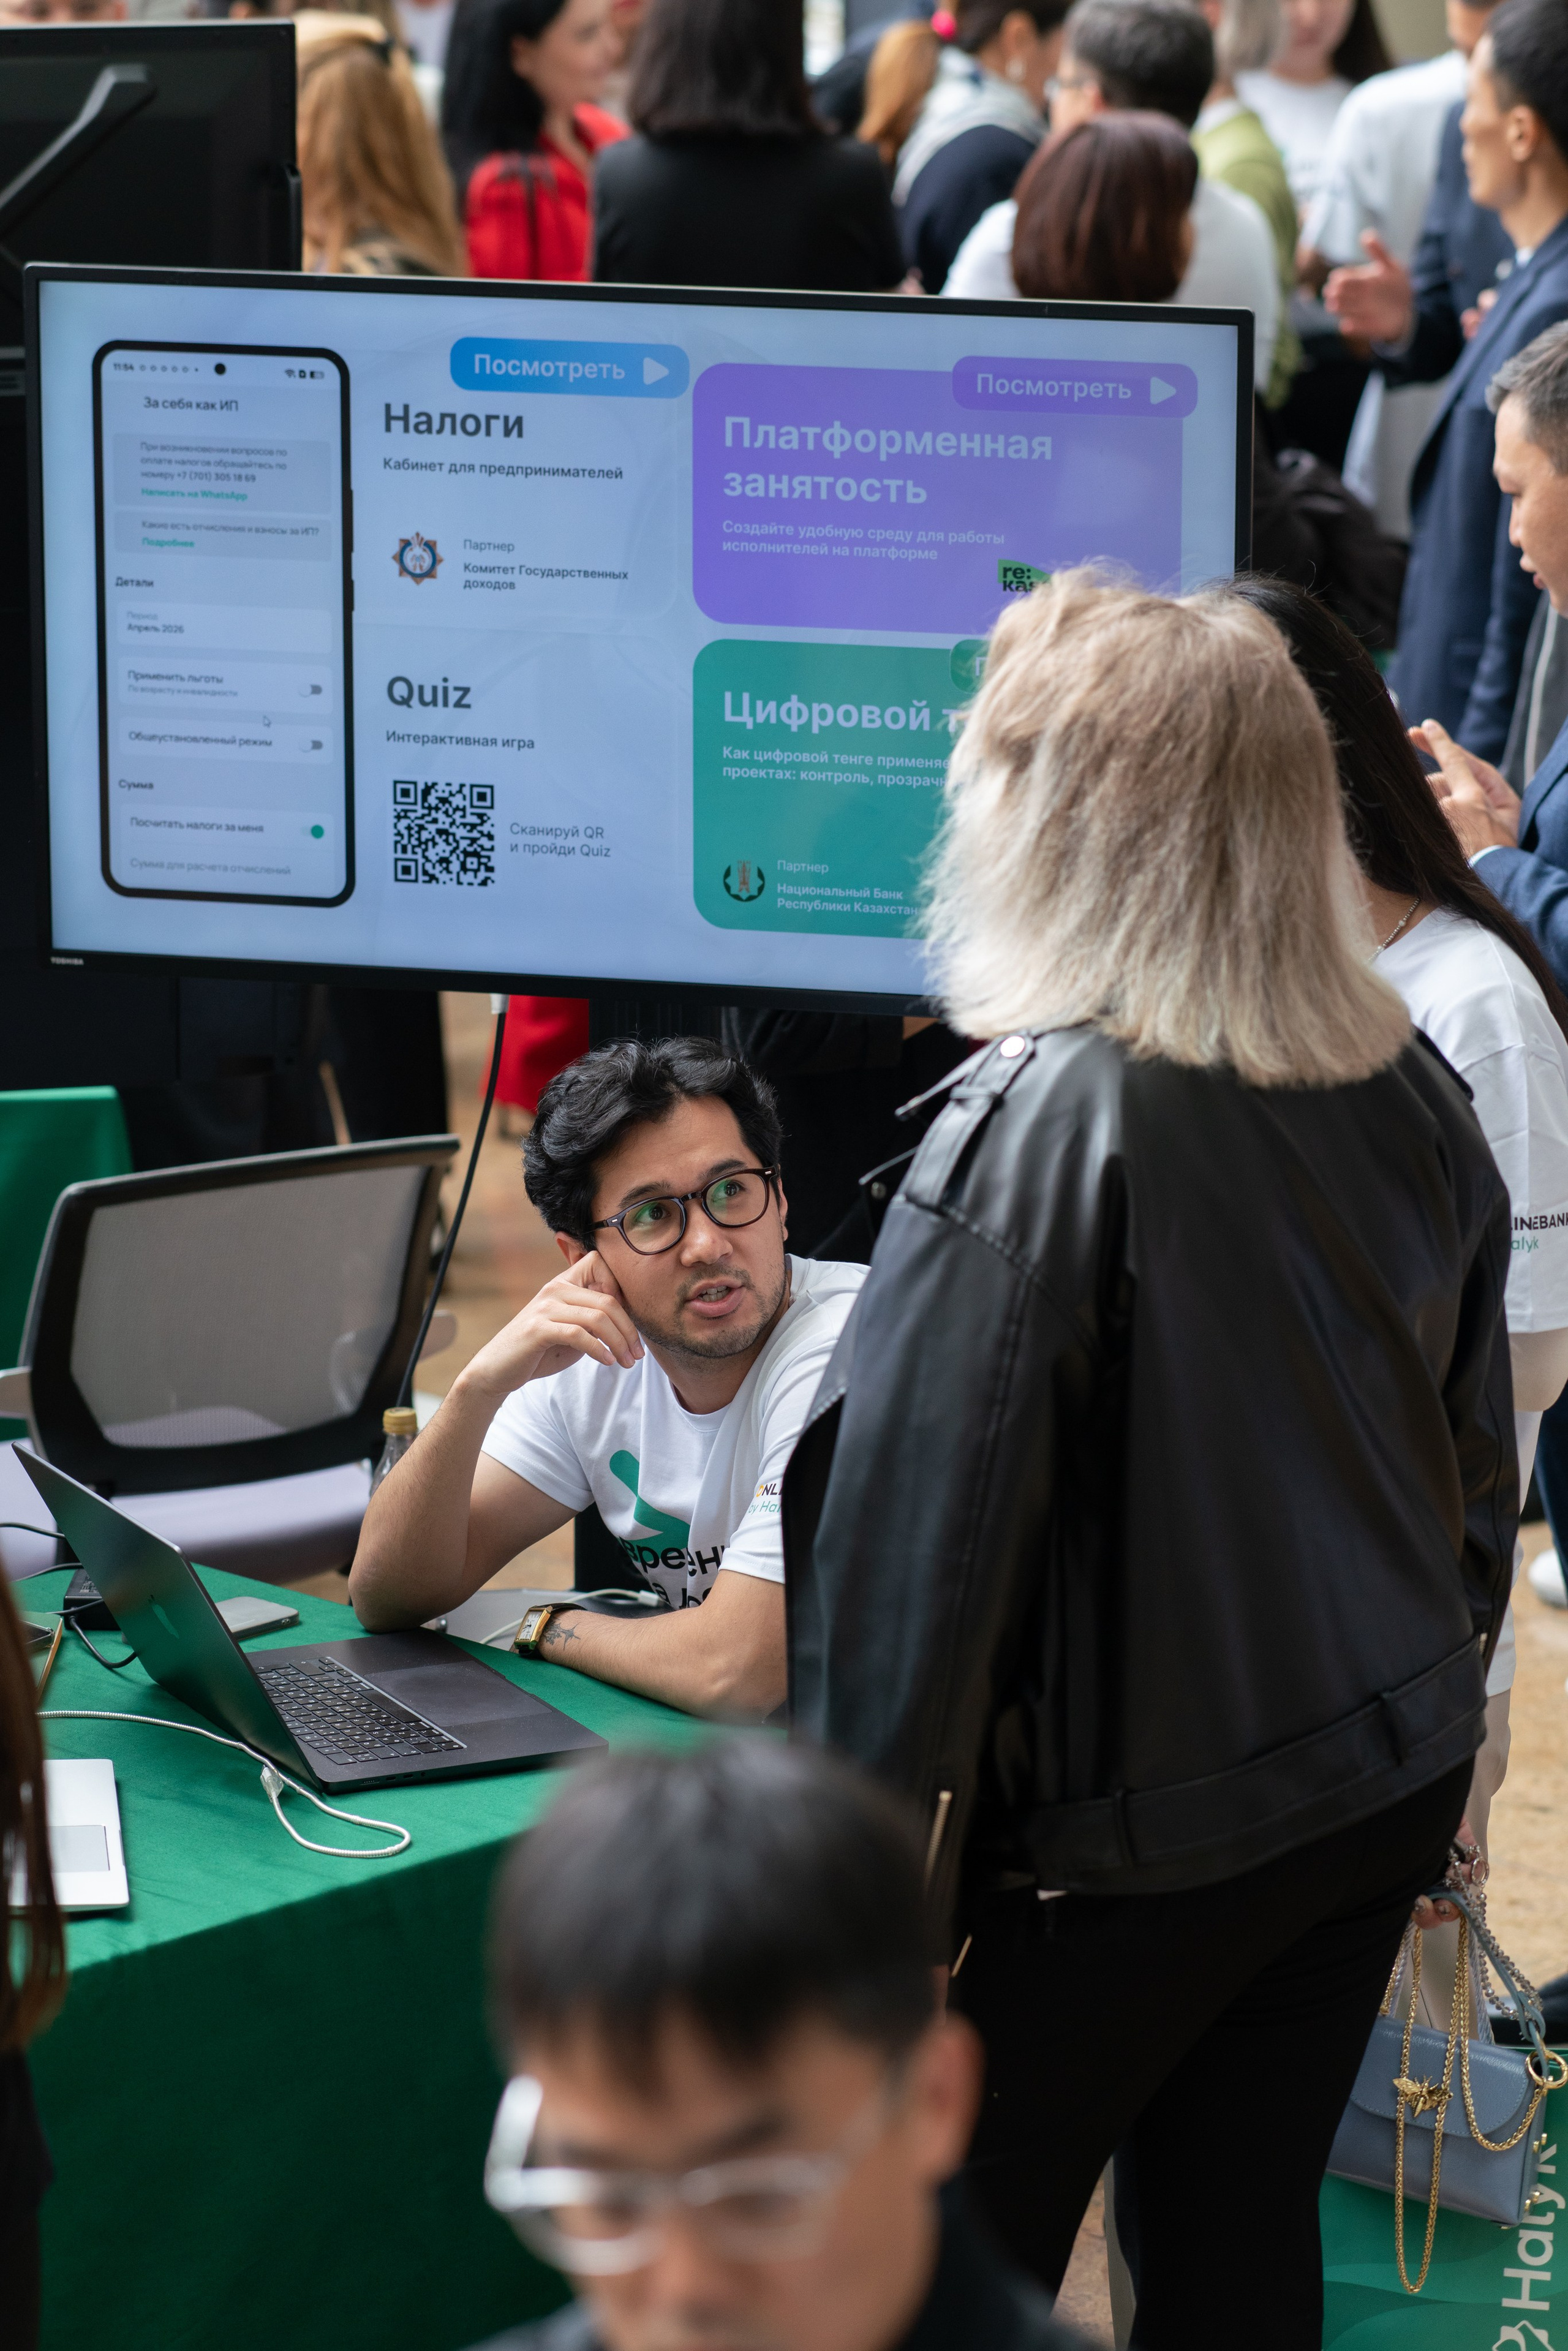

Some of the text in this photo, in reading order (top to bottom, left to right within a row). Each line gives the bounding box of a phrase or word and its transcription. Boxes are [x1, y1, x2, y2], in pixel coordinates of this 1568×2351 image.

[474, 353, 625, 382] Посмотреть
[976, 373, 1132, 402] Посмотреть
[144, 396, 239, 412] За себя как ИП
[383, 402, 524, 439] Налоги
[724, 416, 1052, 462] Платформенная
[140, 442, 158, 451] При
[231, 448, 274, 456] вопросов
[140, 457, 173, 466] оплате
[175, 459, 211, 467] налогов
[213, 459, 274, 470] обращайтесь
[383, 457, 624, 480] Кабинет для предпринимателей
[141, 471, 174, 481] номеру
[189, 472, 211, 482] (701)
[214, 473, 231, 481] 305
[141, 488, 186, 497] Написать
[200, 491, 248, 502] WhatsApp
[723, 472, 927, 504] занятость
[301, 527, 319, 536] ИП?
[722, 520, 1005, 546] Создайте удобную среду для работы
[141, 537, 194, 548] Подробнее
[463, 539, 514, 553] Партнер
[722, 539, 938, 561] исполнителей на платформе
[463, 563, 628, 580] Комитет Государственных
[1003, 567, 1031, 579] re:
[115, 576, 154, 587] Детали
[463, 579, 516, 591] доходов
[127, 623, 160, 633] Апрель
[128, 670, 224, 684] Применить льготы
[386, 676, 472, 709] Quiz
[723, 690, 930, 734] Цифровой
[129, 731, 272, 747] Общеустановленный режим
[385, 730, 535, 751] Интерактивная игра
[722, 746, 950, 771] Как цифровой тенге применяе
[119, 779, 154, 790] Сумма
[722, 766, 947, 789] проектах: контроль, прозрачн
[130, 817, 184, 829] Посчитать
[186, 821, 222, 831] налоги
[510, 822, 604, 839] Сканируй QR
[510, 841, 611, 858] и пройди Quiz
[130, 858, 164, 869] Сумма
[187, 863, 228, 874] расчета
[230, 866, 291, 875] отчислений
[777, 859, 829, 874] Партнер
[777, 883, 903, 900] Национальный Банк
[777, 898, 919, 915] Республики Казахстан
[50, 956, 84, 965] TOSHIBA
[1511, 1236, 1539, 1253] alyk
